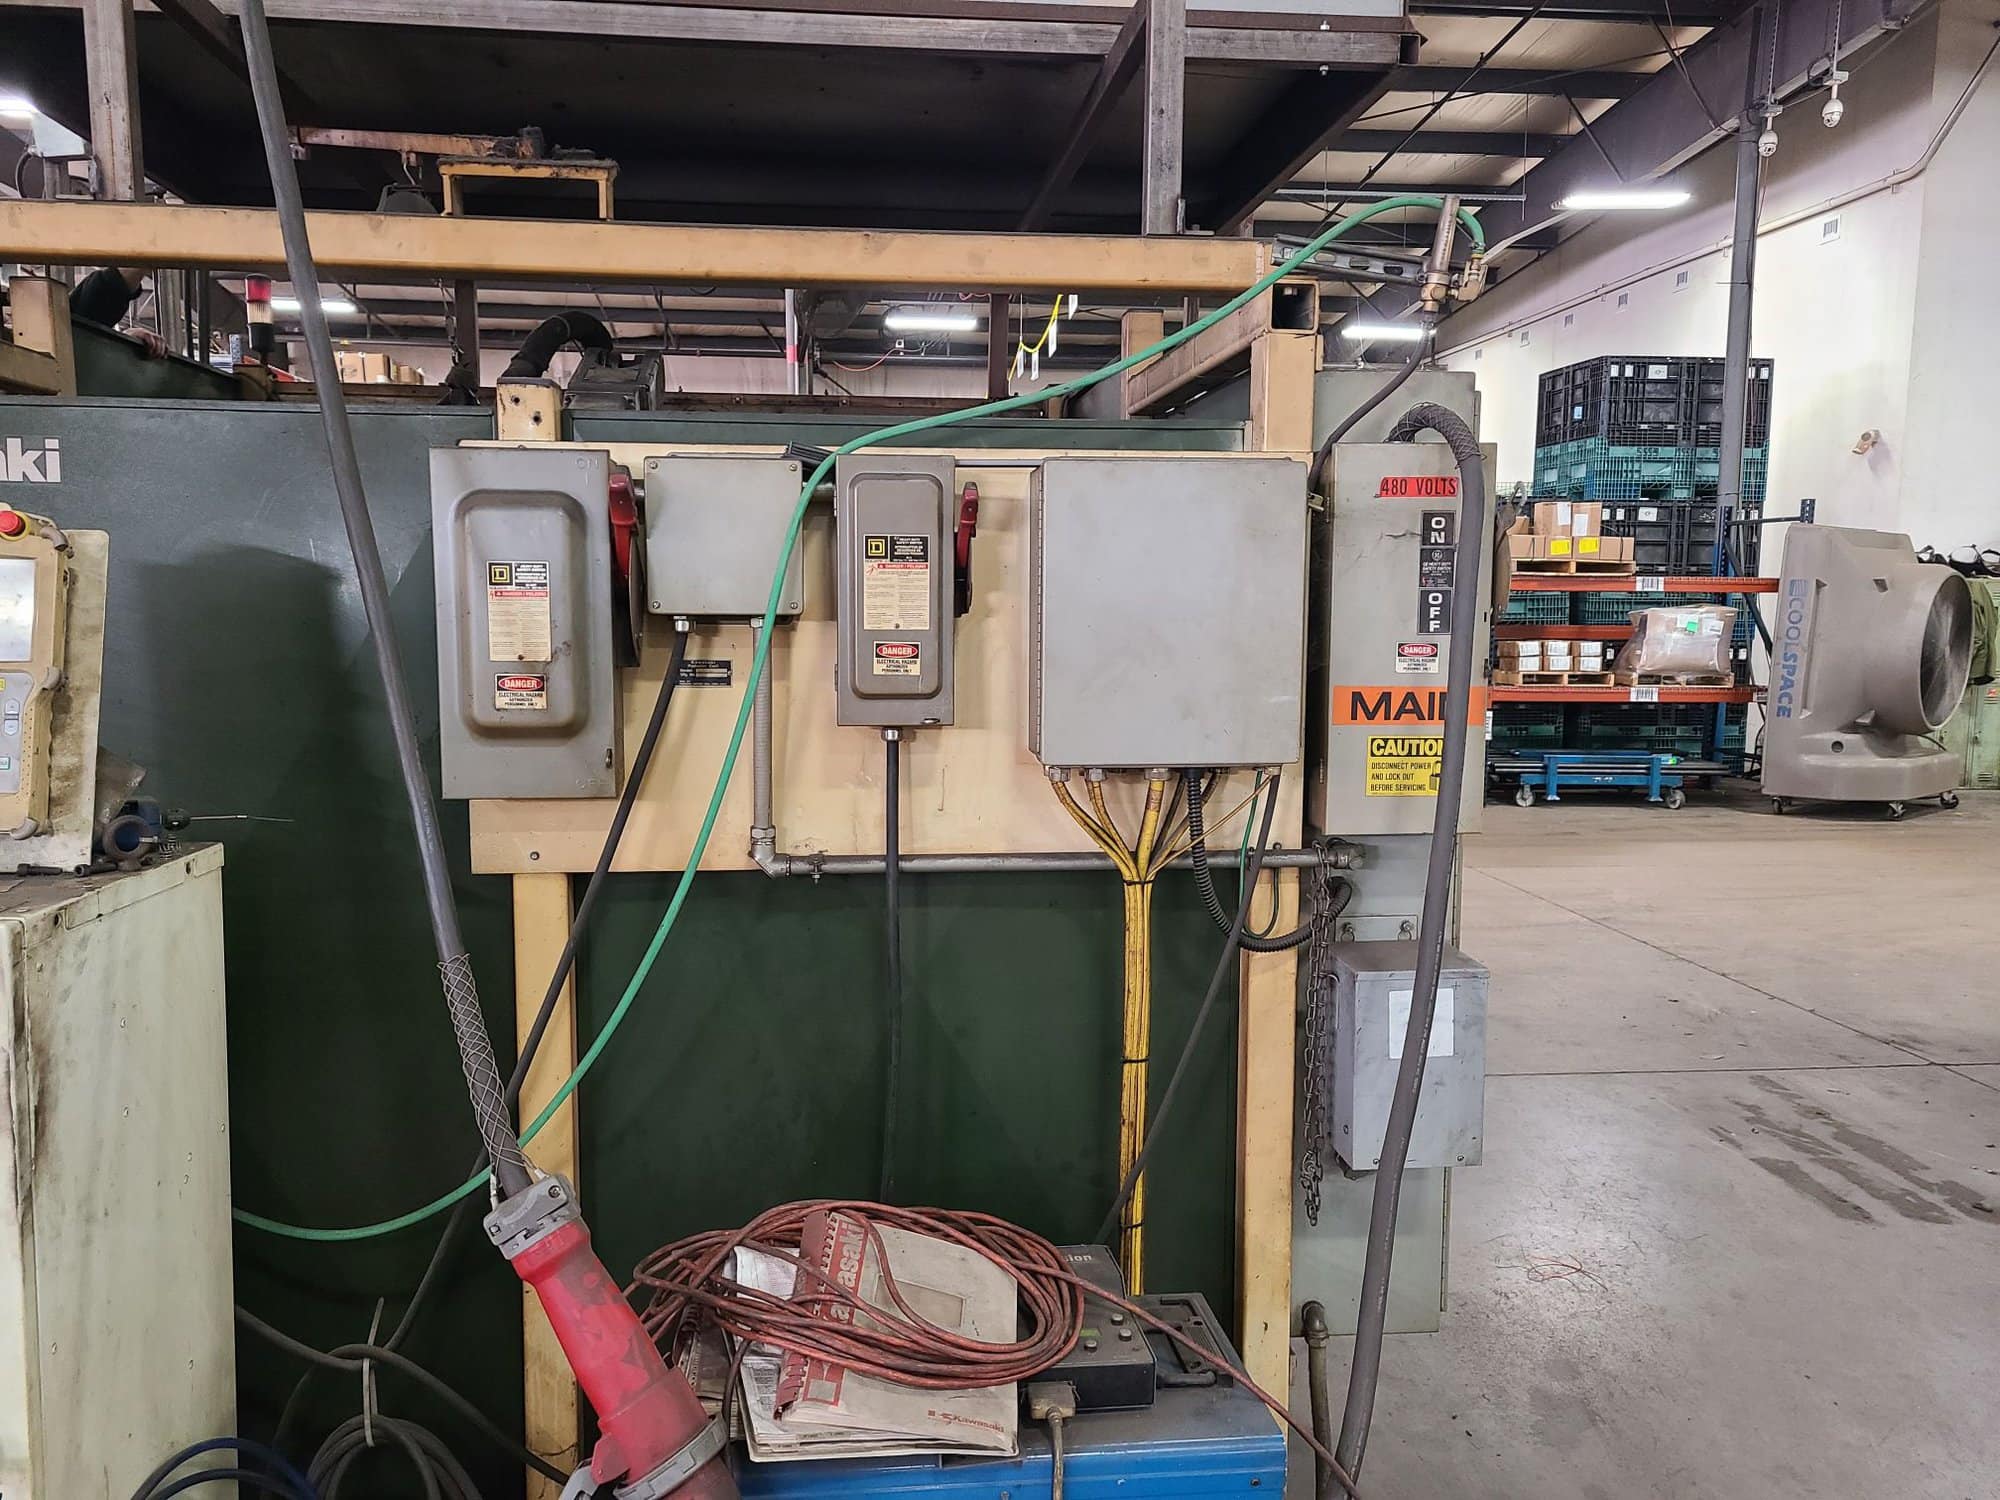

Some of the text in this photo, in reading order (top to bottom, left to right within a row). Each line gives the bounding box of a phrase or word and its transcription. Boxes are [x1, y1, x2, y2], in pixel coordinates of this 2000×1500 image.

[1381, 478, 1458, 495] 480 VOLTS
[1430, 516, 1446, 544] ON
[1427, 592, 1443, 632] OFF
[882, 646, 912, 655] DANGER
[1404, 646, 1432, 655] DANGER
[1776, 598, 1804, 719] COOLSPACE
[503, 679, 538, 688] DANGER
[1371, 761, 1432, 770] DISCONNECT POWER
[1371, 772, 1415, 781] AND LOCK OUT
[1370, 783, 1427, 792] BEFORE SERVICING
[954, 1414, 1005, 1433] Kawasaki
